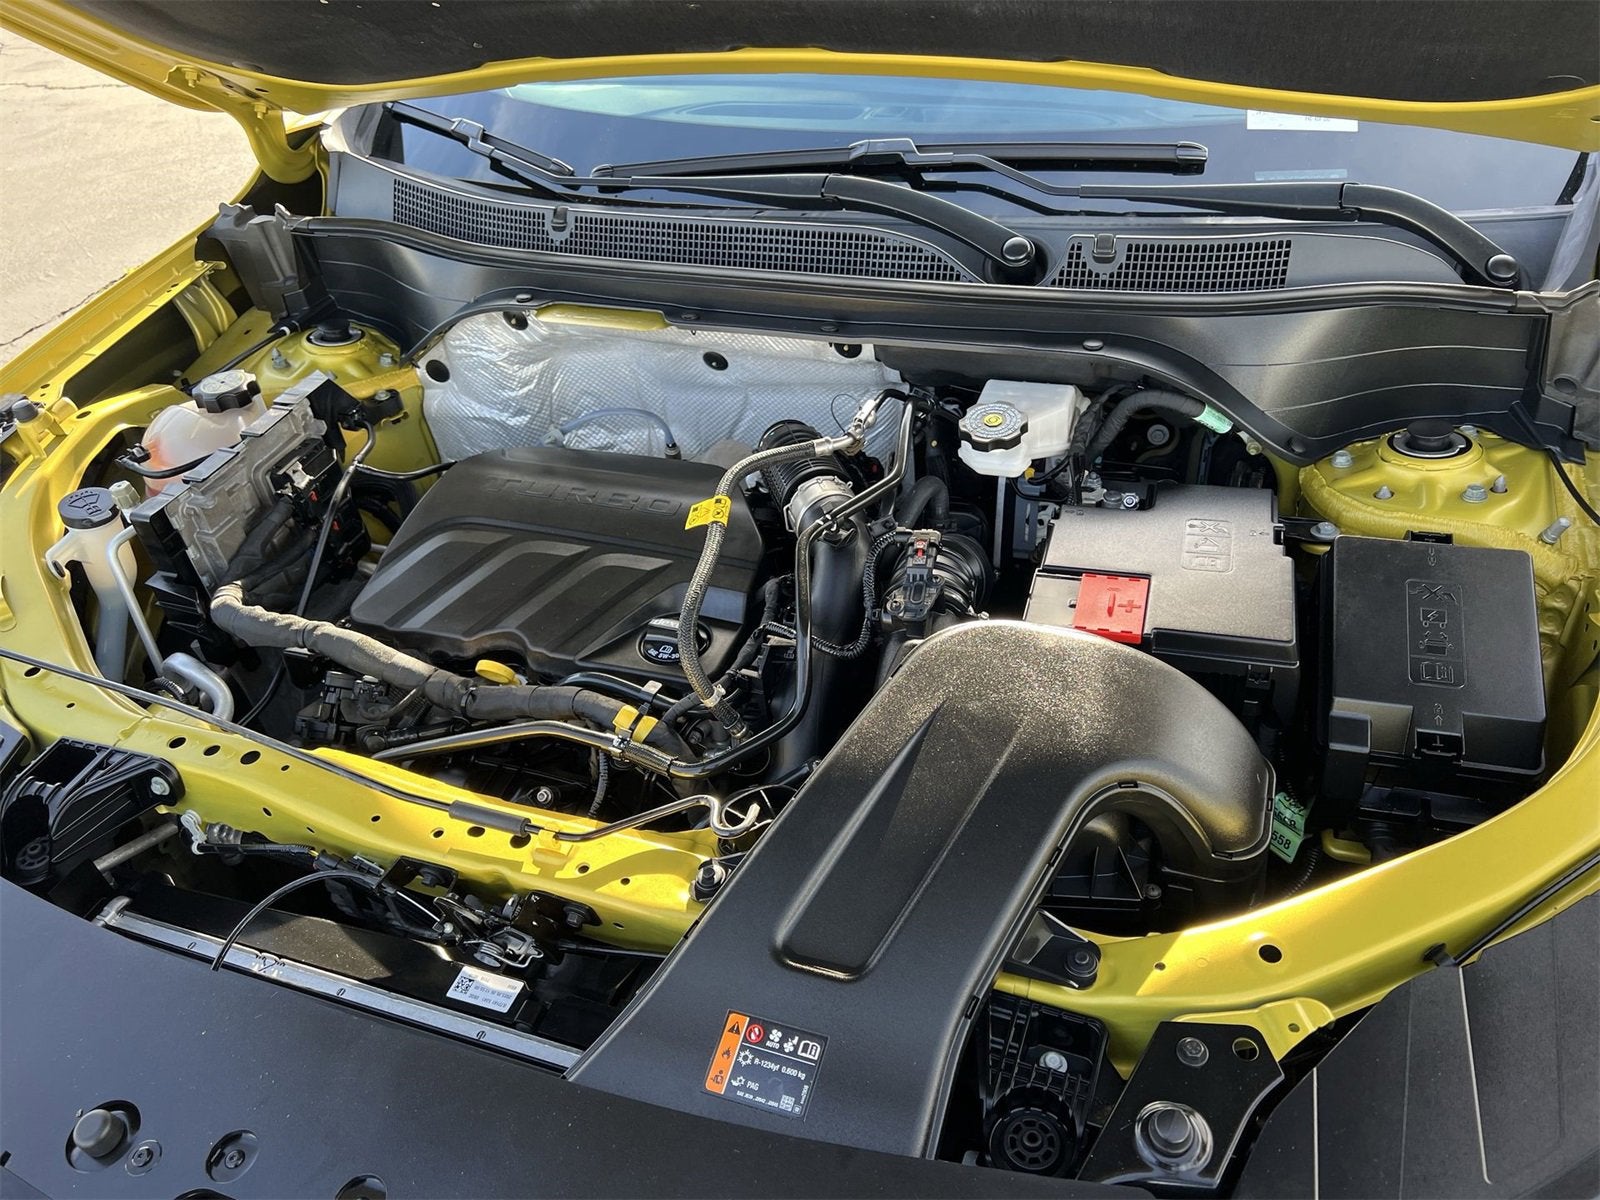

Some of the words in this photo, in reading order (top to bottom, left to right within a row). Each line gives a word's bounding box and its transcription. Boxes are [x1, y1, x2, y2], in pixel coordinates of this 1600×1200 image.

[484, 476, 681, 516] TURBO
[651, 618, 680, 628] dex
[766, 1041, 779, 1049] AUTO
[754, 1058, 780, 1071] R-1234yf
[798, 1070, 806, 1080] kg
[746, 1081, 759, 1091] PAG
